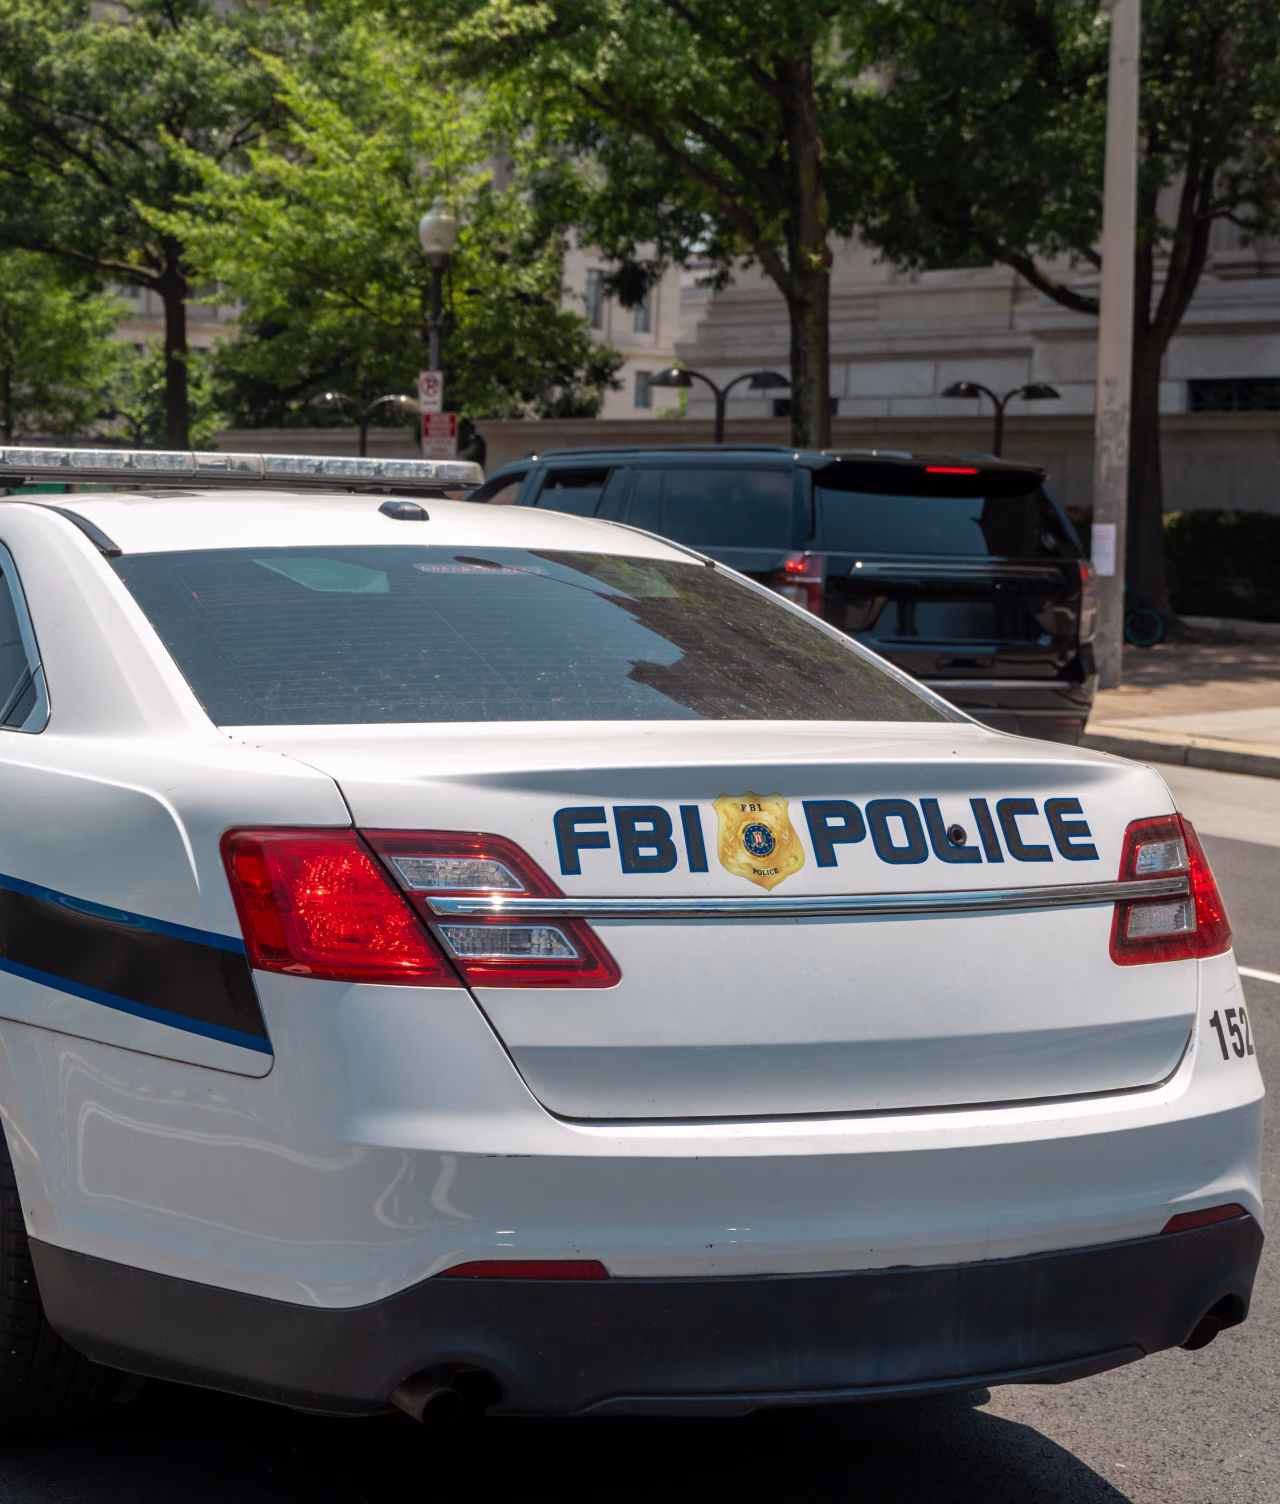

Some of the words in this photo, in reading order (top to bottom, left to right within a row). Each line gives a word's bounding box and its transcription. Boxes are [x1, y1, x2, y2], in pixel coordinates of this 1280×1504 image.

[741, 804, 762, 812] FBI
[553, 805, 709, 875] FBI
[802, 797, 1100, 868] POLICE
[752, 867, 779, 876] POLICE
[1209, 1006, 1255, 1061] 152
